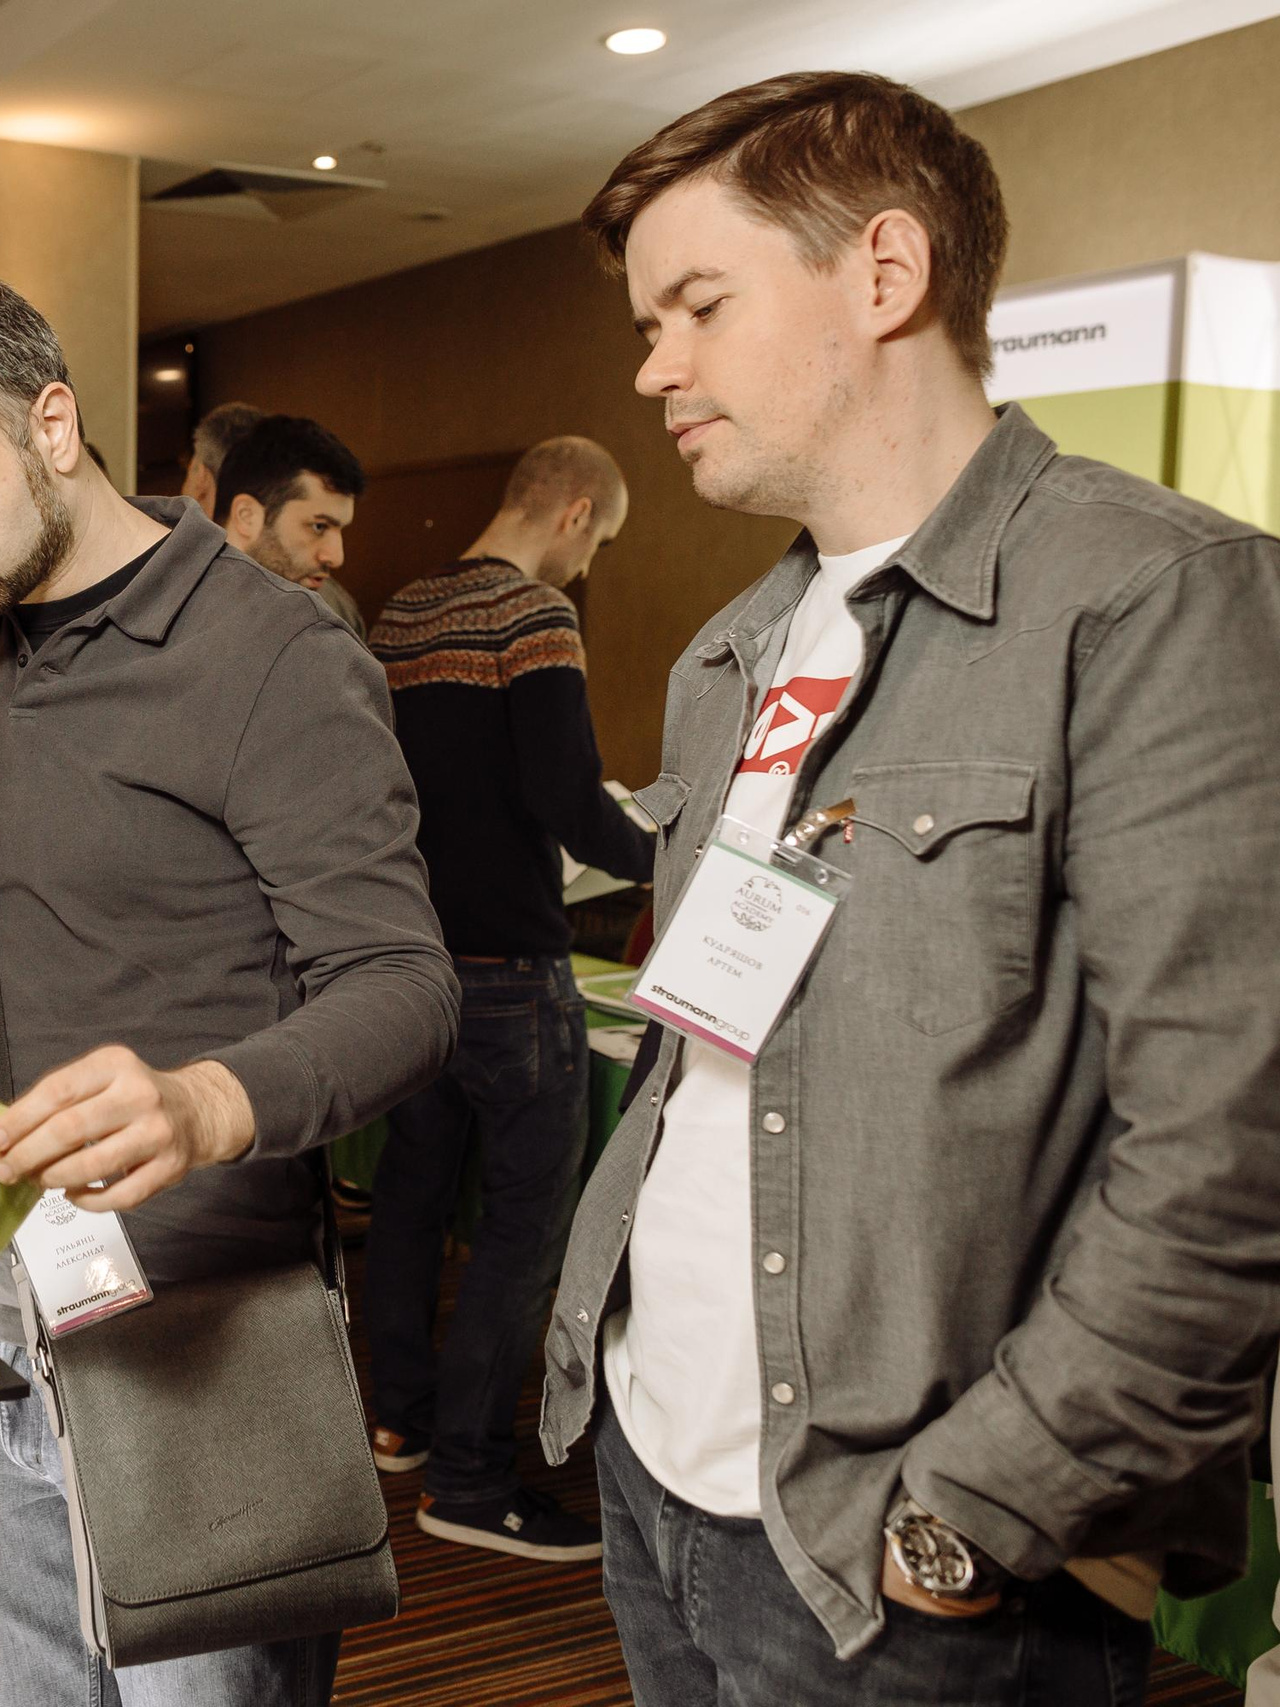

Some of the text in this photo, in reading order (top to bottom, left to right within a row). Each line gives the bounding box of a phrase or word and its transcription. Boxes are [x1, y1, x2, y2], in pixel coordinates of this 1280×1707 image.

[992, 323, 1106, 353] raumann
[733, 901, 775, 922] ACADEMY
[735, 887, 783, 914] AURUM
[702, 935, 763, 970] КУДРЯШОВ
[707, 956, 742, 978] АРТЕМ
[650, 984, 750, 1041] straumanngroup
[40, 1194, 65, 1209] AURU
[45, 1203, 72, 1219] ACADEM
[56, 1235, 95, 1256] ГУЛЬЯНЦ
[56, 1245, 105, 1270] АЛЕКСАНДР
